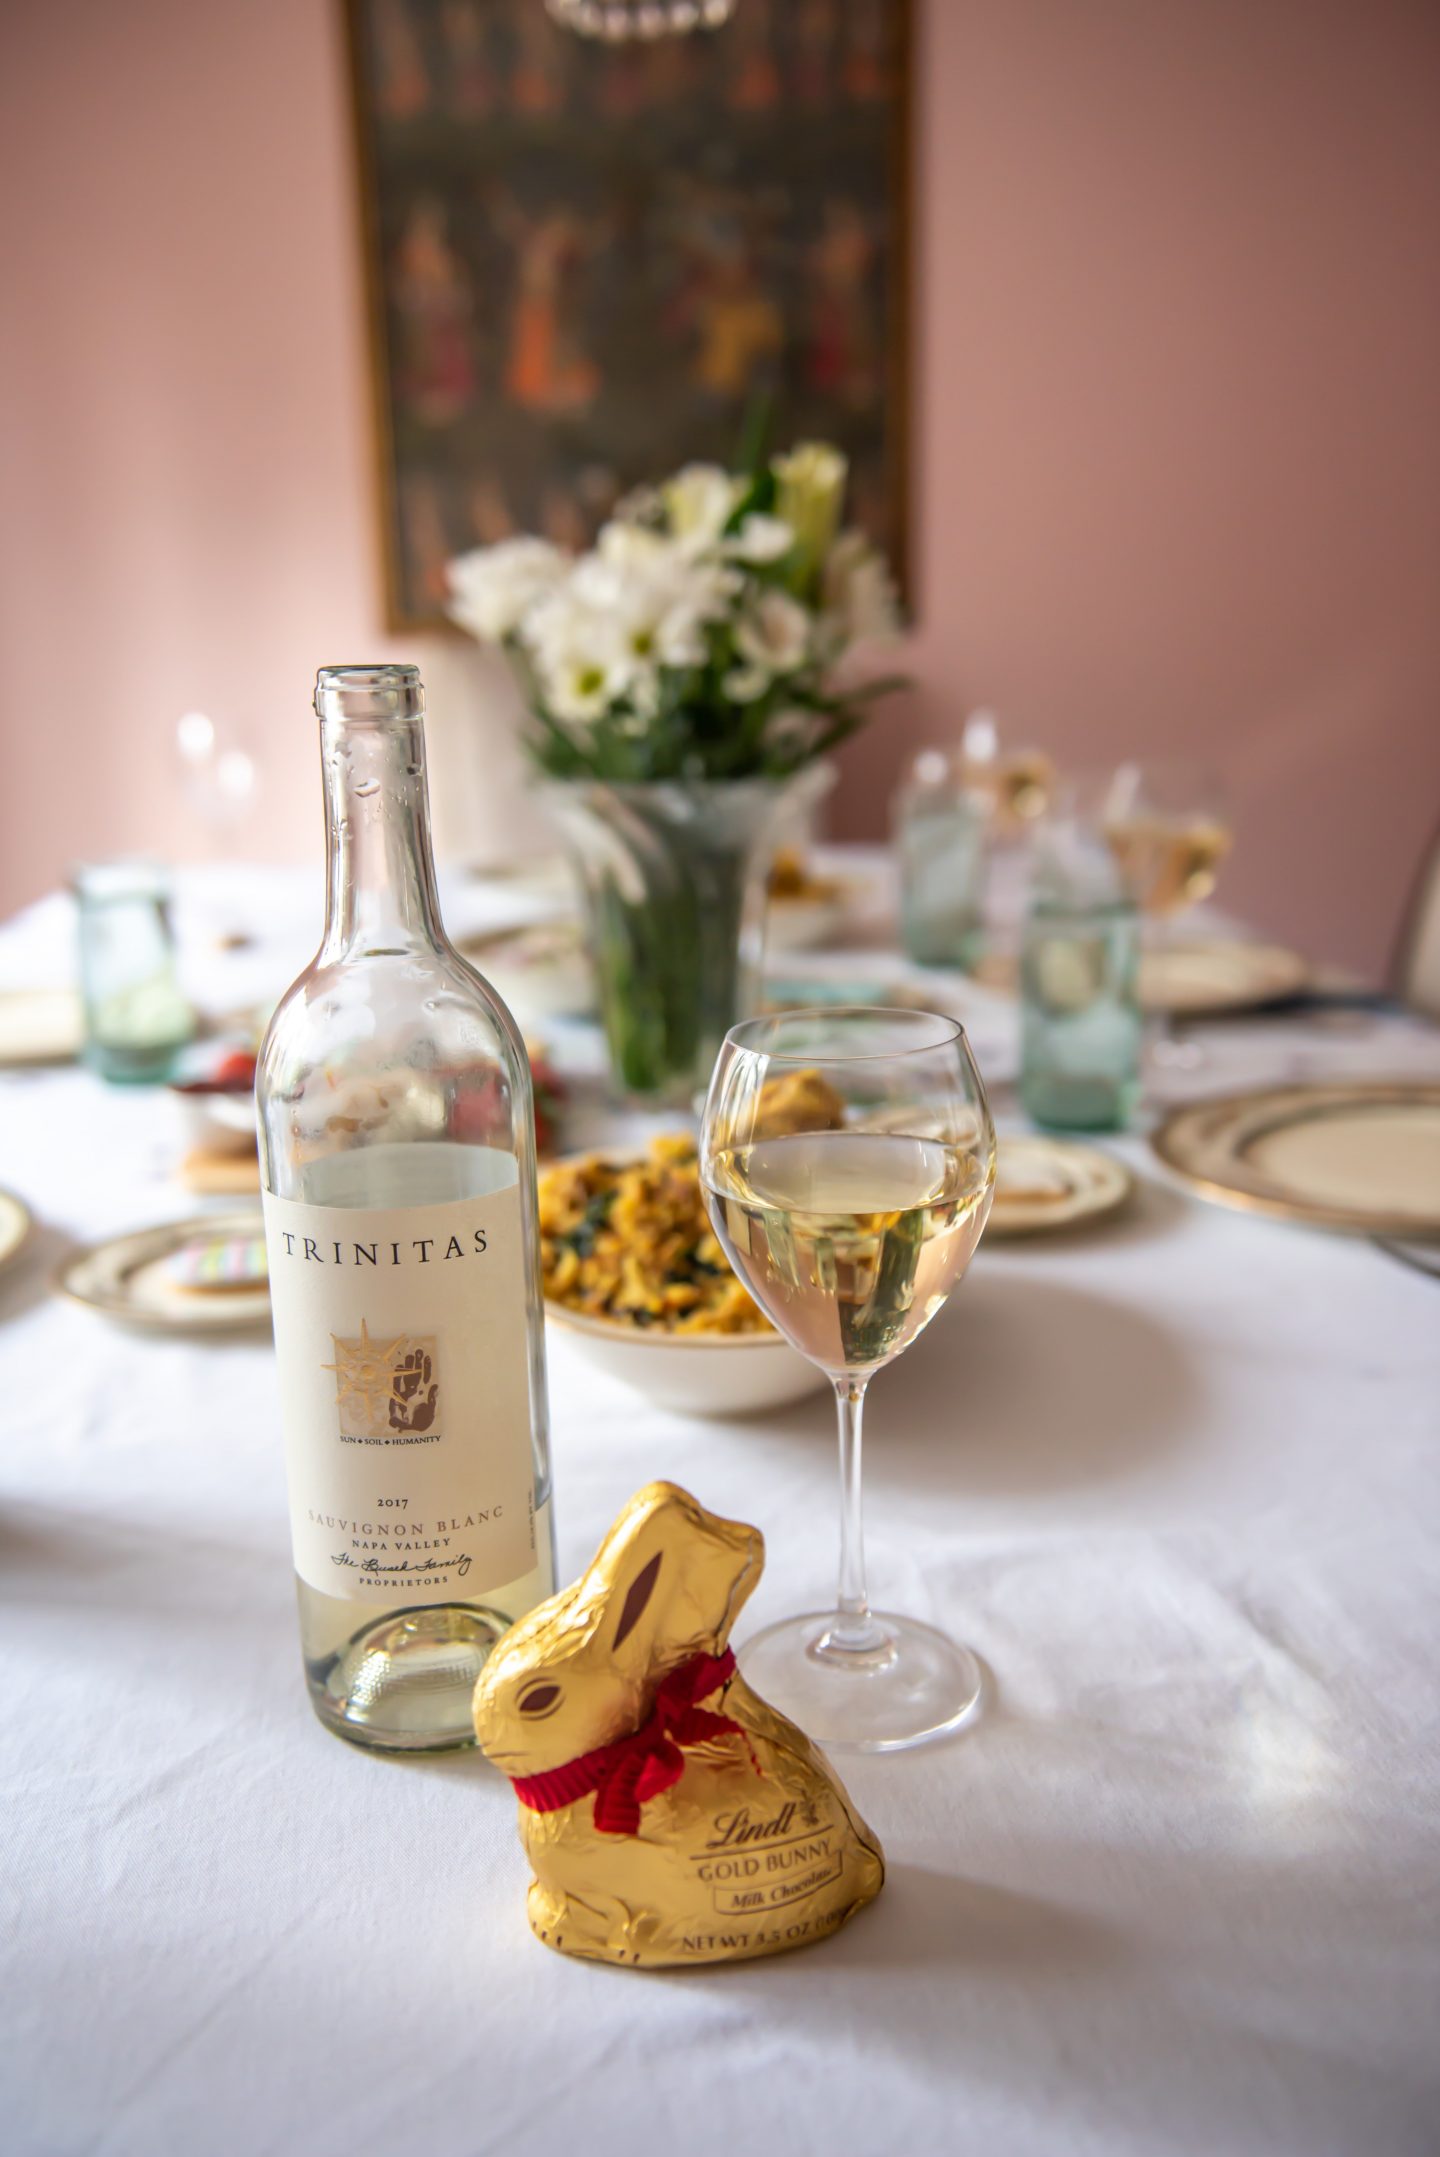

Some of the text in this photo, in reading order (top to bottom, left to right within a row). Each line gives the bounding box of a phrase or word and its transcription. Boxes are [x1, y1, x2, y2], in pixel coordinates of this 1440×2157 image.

[282, 1229, 488, 1266] TRINITAS
[340, 1434, 441, 1446] SUN SOIL HUMANITY
[377, 1498, 409, 1510] 2017
[308, 1510, 424, 1536] SAUVIGNON
[437, 1505, 504, 1533] BLANC
[352, 1538, 451, 1551] NAPA VALLEY
[331, 1552, 359, 1569] The
[415, 1553, 473, 1577] Family
[359, 1575, 448, 1588] PROPRIETORS
[706, 1803, 796, 1848] Lindt
[697, 1839, 831, 1882] GOLD BUNNY
[730, 1894, 765, 1909] Milk
[682, 1935, 717, 1951] NET
[719, 1934, 749, 1948] WT
[786, 1922, 812, 1939] OZ
